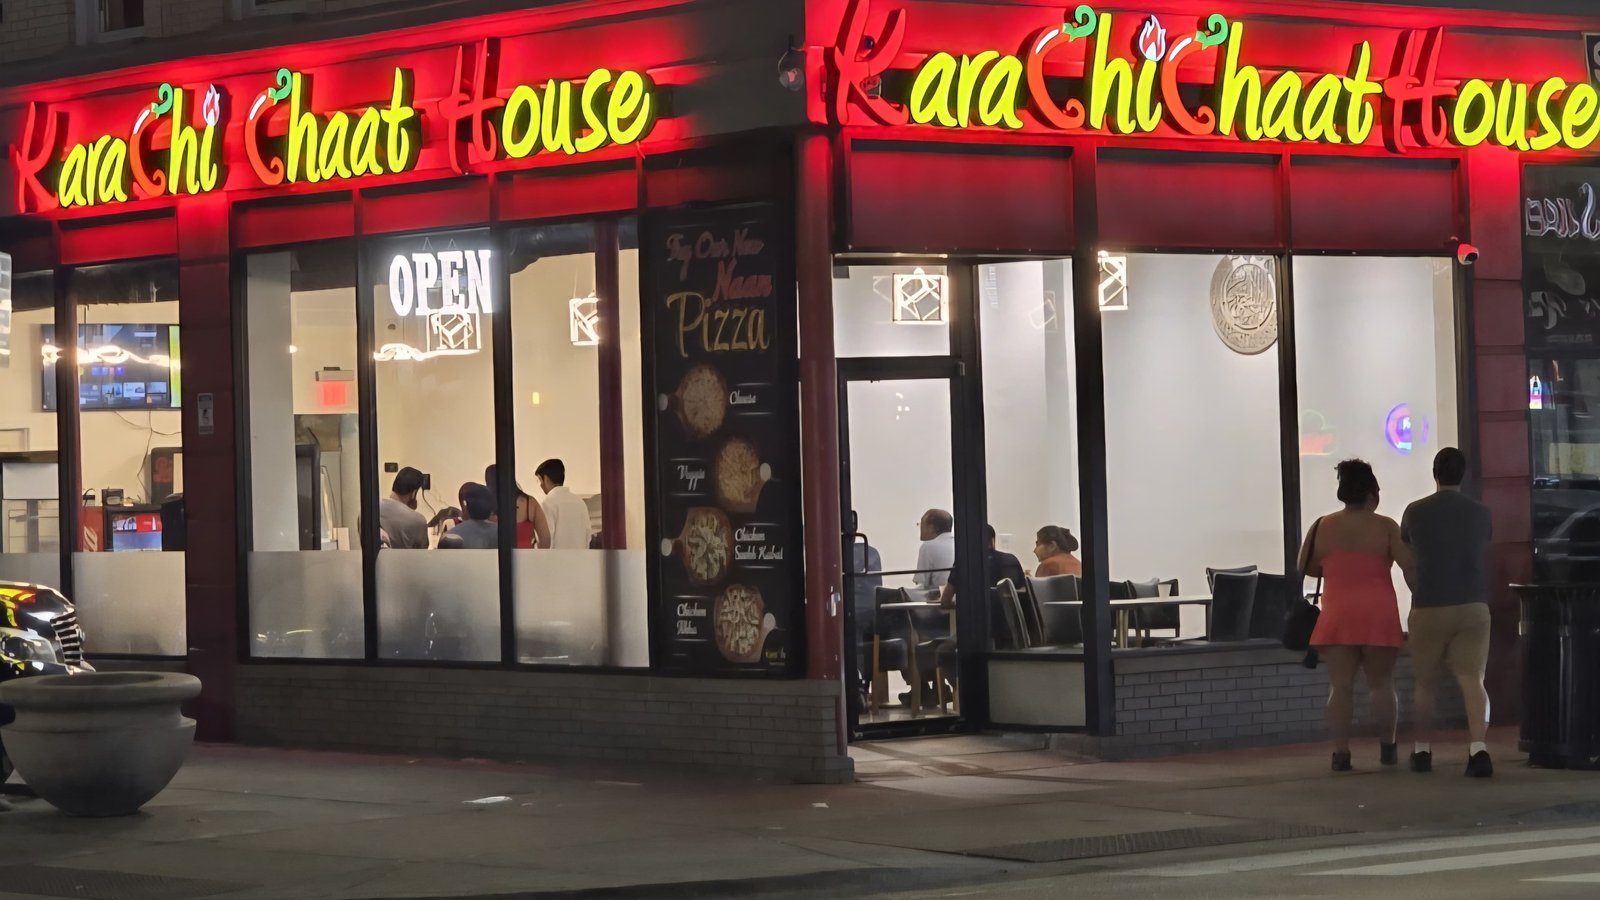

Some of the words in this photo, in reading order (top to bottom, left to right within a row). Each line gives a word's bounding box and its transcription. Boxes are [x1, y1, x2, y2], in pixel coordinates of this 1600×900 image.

[244, 67, 415, 186] Chaat
[439, 38, 652, 174] House
[1160, 14, 1383, 142] Chaat
[1384, 26, 1600, 152] House
[389, 249, 493, 316] OPEN
[667, 292, 770, 358] Pizza
